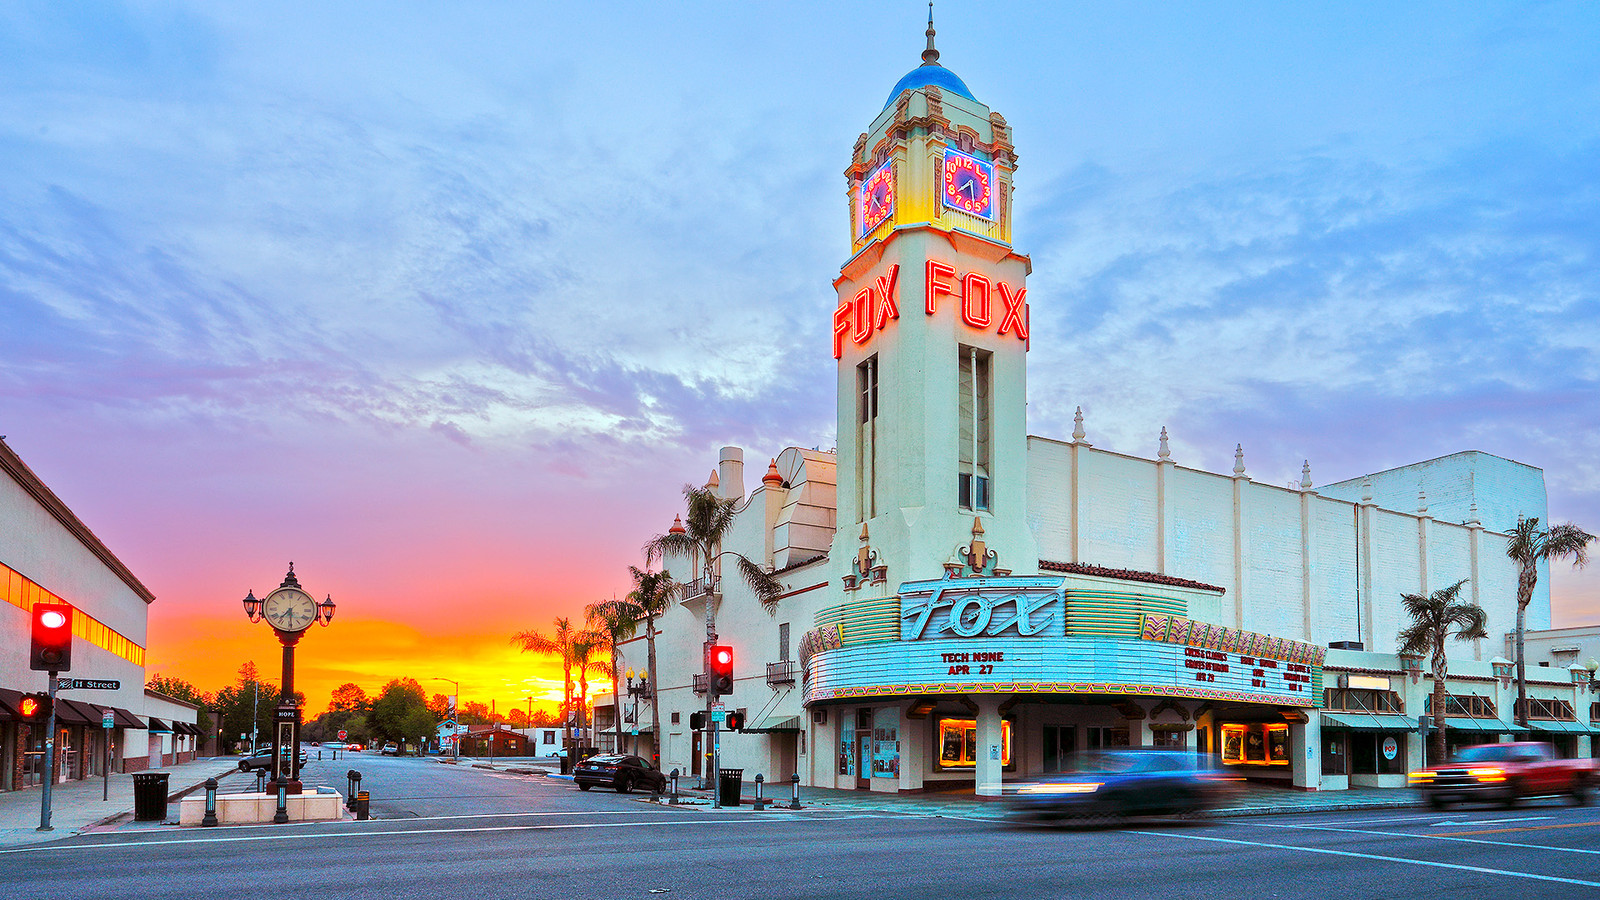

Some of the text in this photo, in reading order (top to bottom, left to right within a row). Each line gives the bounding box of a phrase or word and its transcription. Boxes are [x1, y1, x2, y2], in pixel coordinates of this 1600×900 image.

[945, 161, 957, 174] 10
[963, 158, 974, 170] 12
[946, 172, 953, 183] 9
[981, 174, 988, 185] 2
[947, 184, 956, 196] 8
[984, 187, 991, 197] 3
[955, 195, 962, 205] 7
[964, 200, 972, 211] 6
[981, 197, 989, 207] 4
[880, 205, 887, 217] 5
[974, 201, 982, 213] 5
[925, 259, 1028, 340] FOX
[833, 264, 900, 359] FOX
[897, 570, 1067, 640] Fox
[941, 651, 1004, 663] TECH N9NE
[947, 664, 994, 675] APR 27
[86, 681, 117, 689] Street
